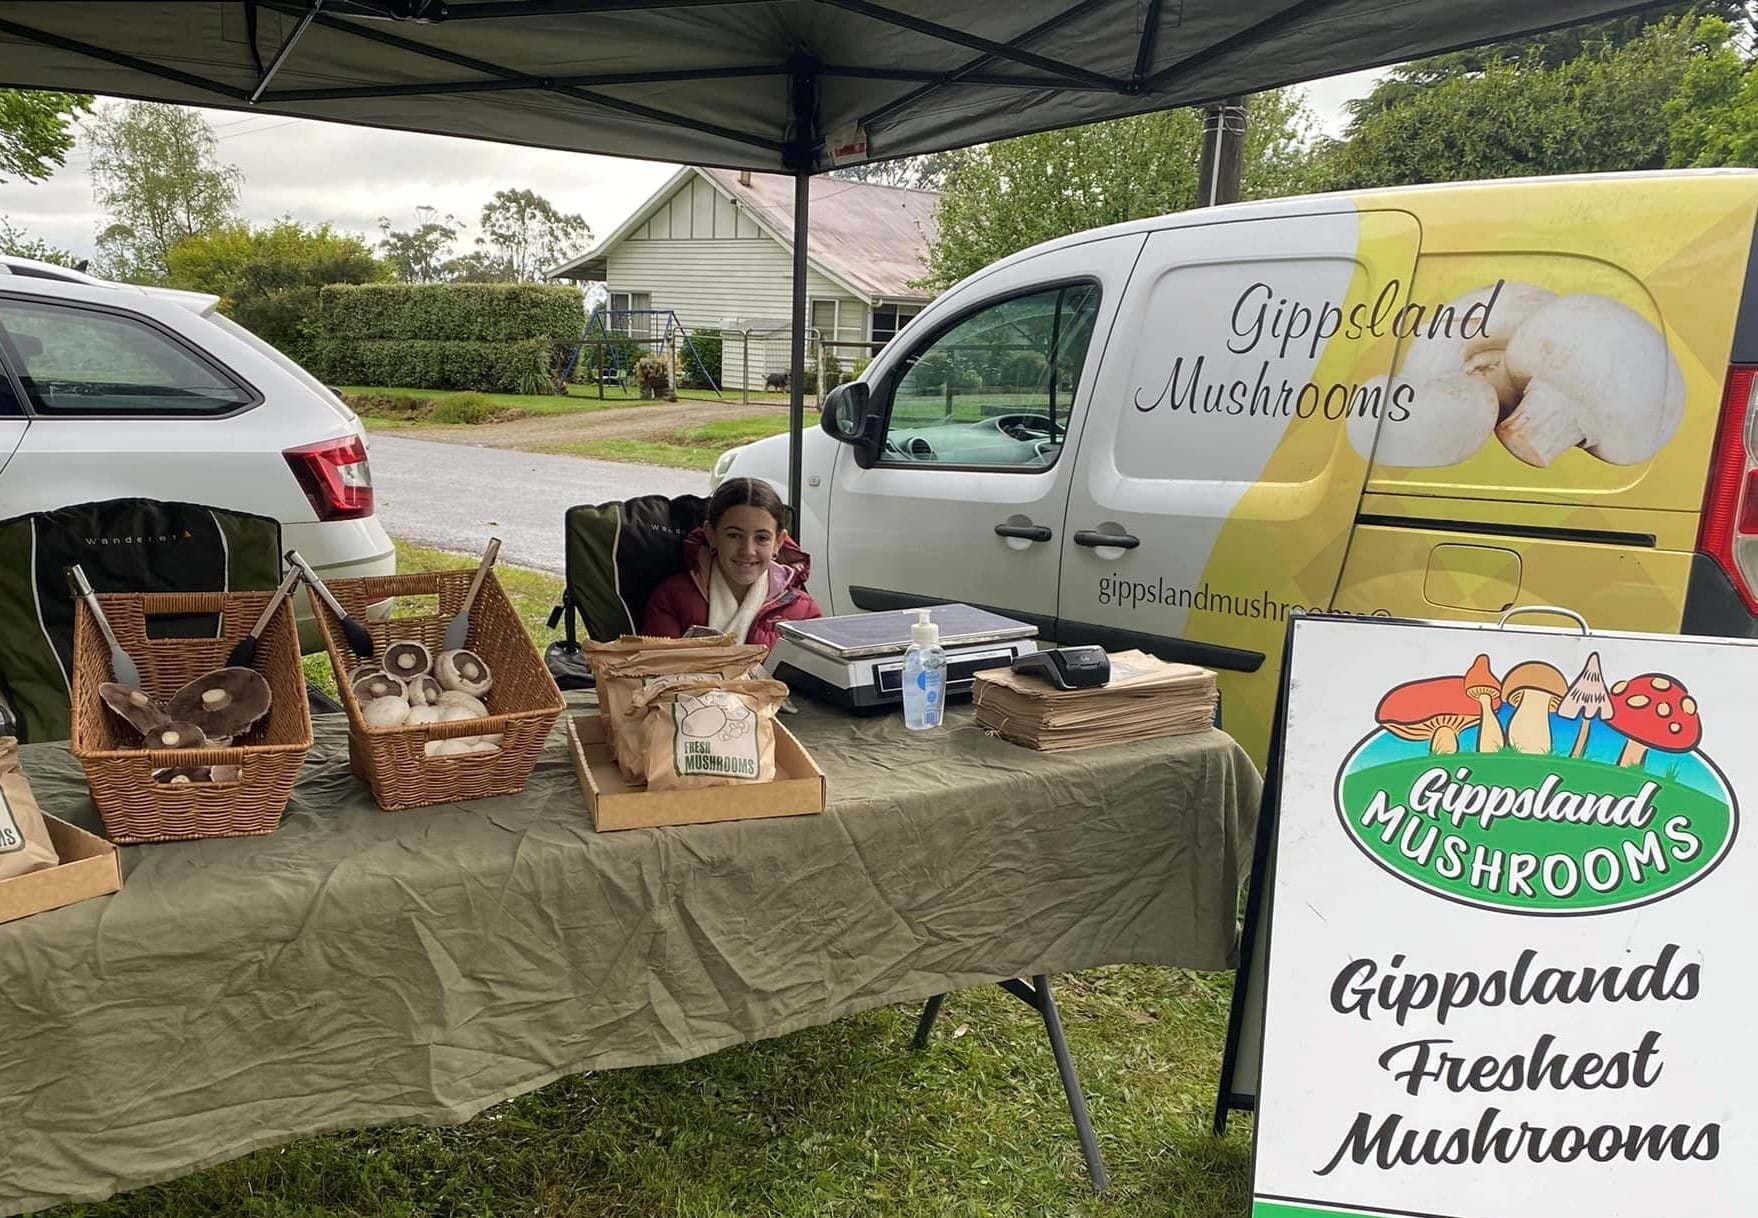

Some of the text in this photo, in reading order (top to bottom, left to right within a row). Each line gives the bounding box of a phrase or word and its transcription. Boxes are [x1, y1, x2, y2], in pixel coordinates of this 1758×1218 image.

[1227, 279, 1505, 359] Gippsland
[1134, 355, 1415, 422] Mushrooms
[684, 741, 711, 754] FRESH
[684, 755, 754, 775] MUSHROOMS
[1409, 767, 1661, 831] Gippsland
[1360, 790, 1702, 898] MUSHROOMS
[1330, 943, 1701, 1026] Gippslands
[1378, 1031, 1664, 1096] Freshest
[1312, 1107, 1721, 1176] Mushrooms
